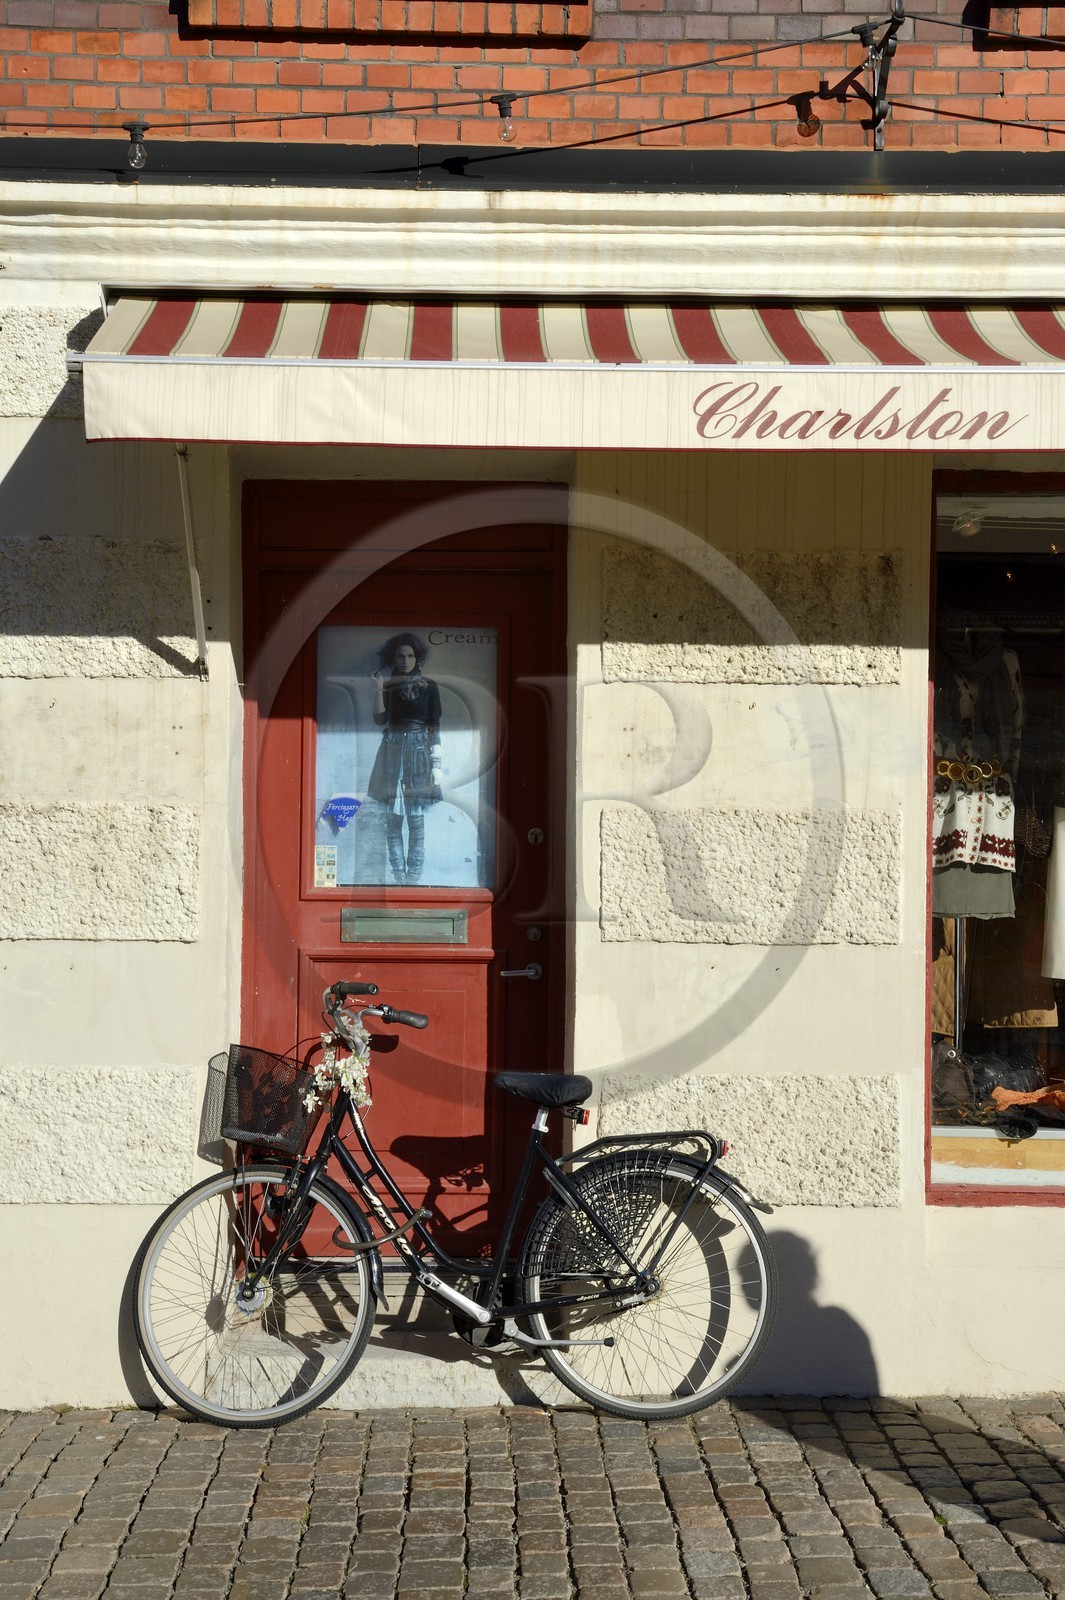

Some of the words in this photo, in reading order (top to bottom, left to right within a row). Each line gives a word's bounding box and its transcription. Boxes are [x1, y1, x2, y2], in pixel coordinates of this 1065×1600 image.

[693, 381, 1029, 440] Charlston
[428, 630, 497, 645] Cream
[362, 1185, 413, 1256] Apolo
